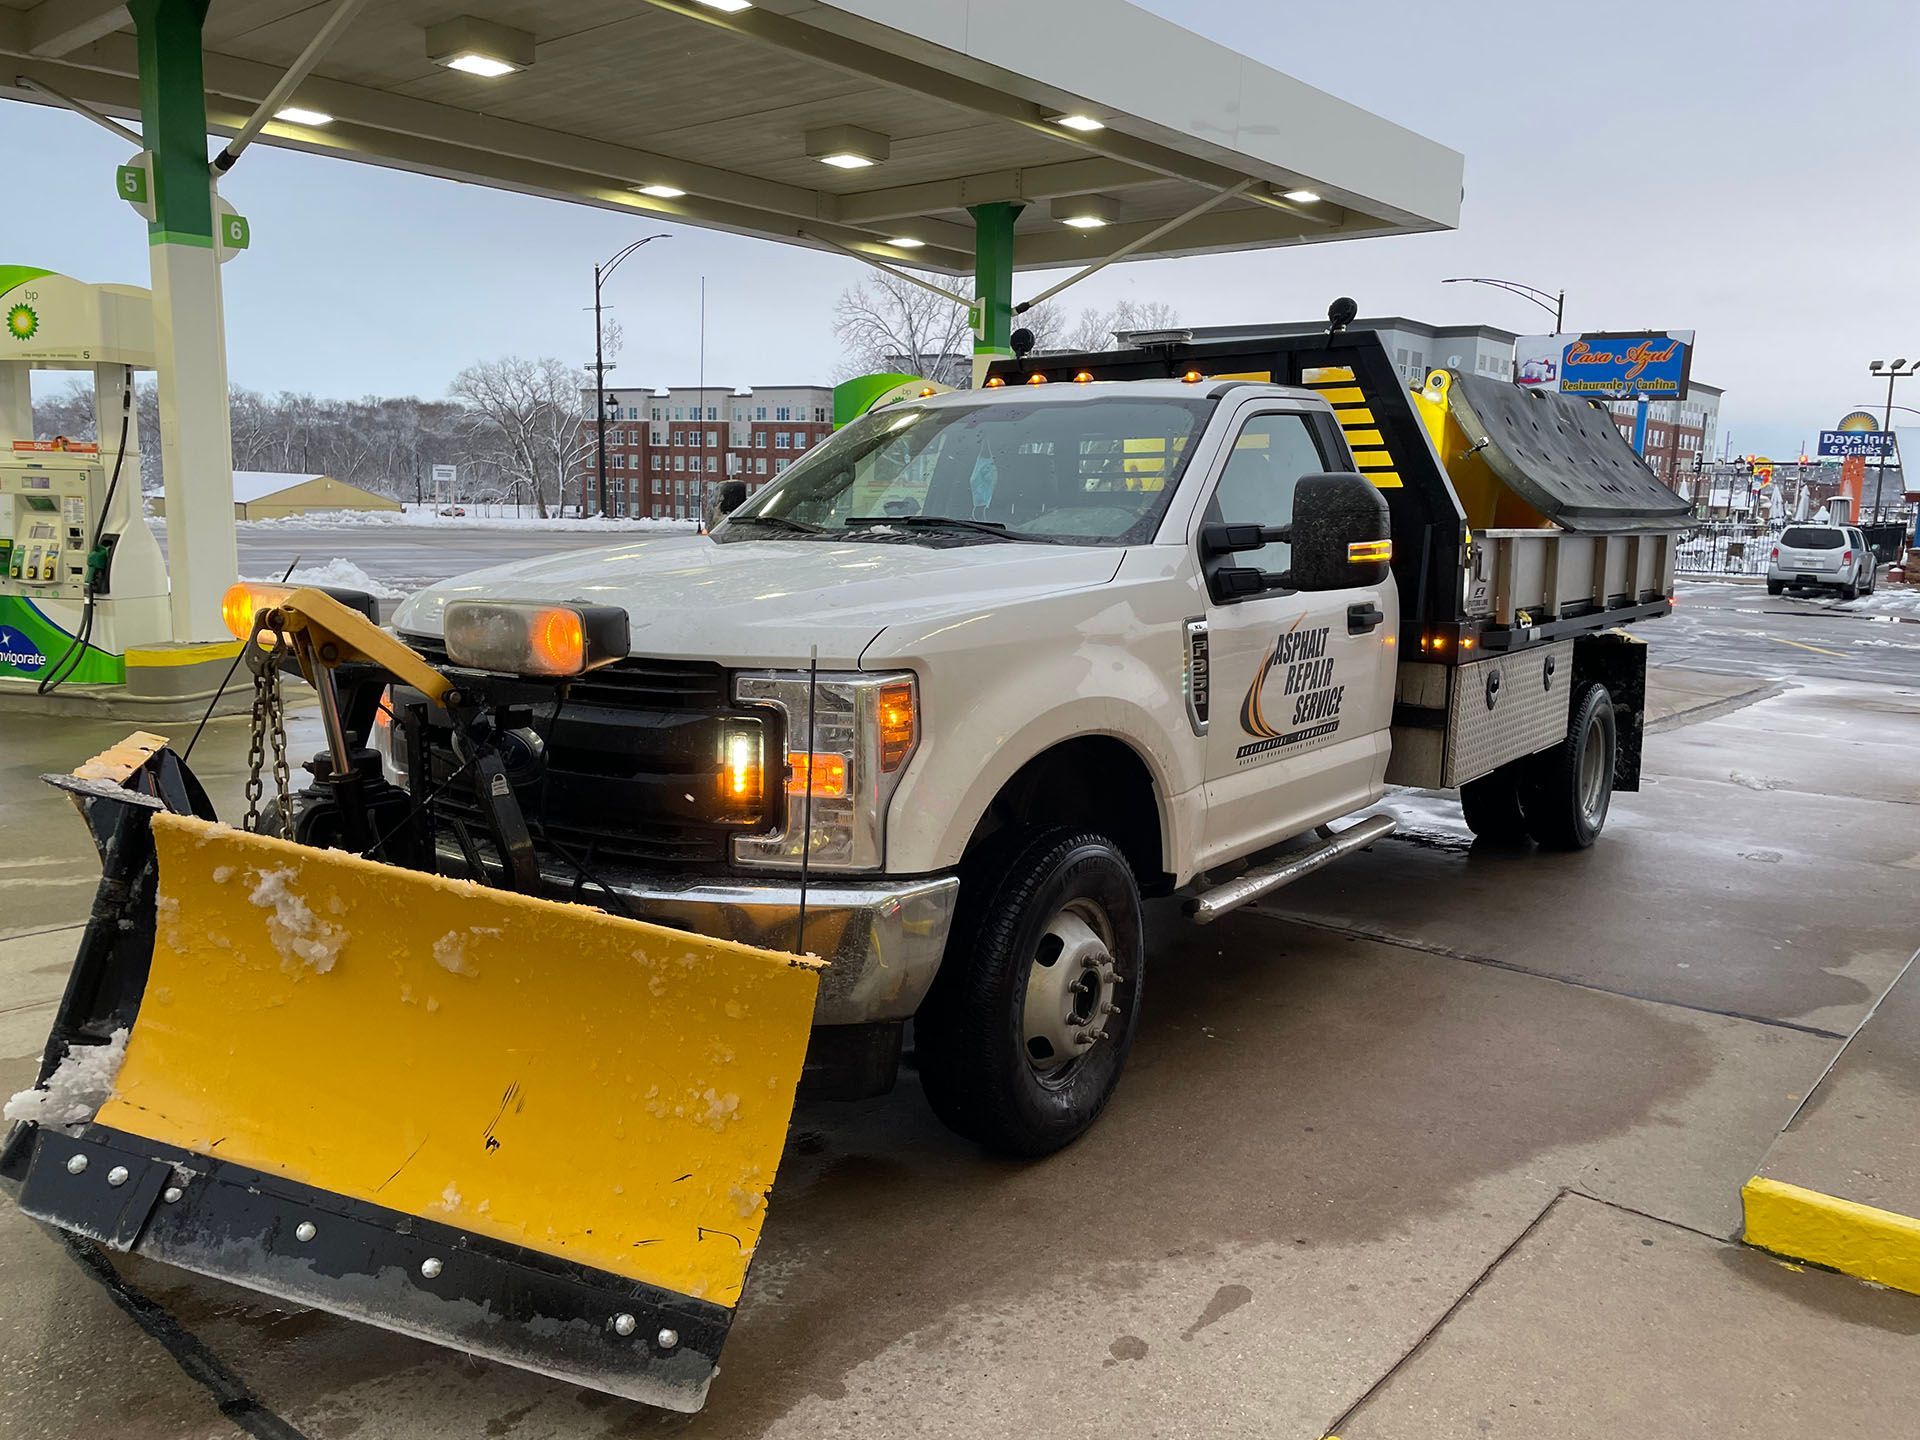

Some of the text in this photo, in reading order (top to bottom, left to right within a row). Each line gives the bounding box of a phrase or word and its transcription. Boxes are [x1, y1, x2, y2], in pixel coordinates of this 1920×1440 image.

[125, 173, 138, 192] 5
[230, 221, 243, 240] 6
[25, 289, 39, 302] bp
[972, 311, 978, 323] 7
[83, 351, 90, 360] 5
[1567, 341, 1680, 380] Casa Azul
[1562, 379, 1677, 393] Restaurante y Cantina
[1823, 433, 1861, 445] Days
[1829, 444, 1881, 455] & Suites
[79, 472, 87, 482] 5
[1273, 627, 1330, 666] ASPHALT
[1284, 657, 1335, 696] REPAIR
[1292, 685, 1345, 726] SERVICE
